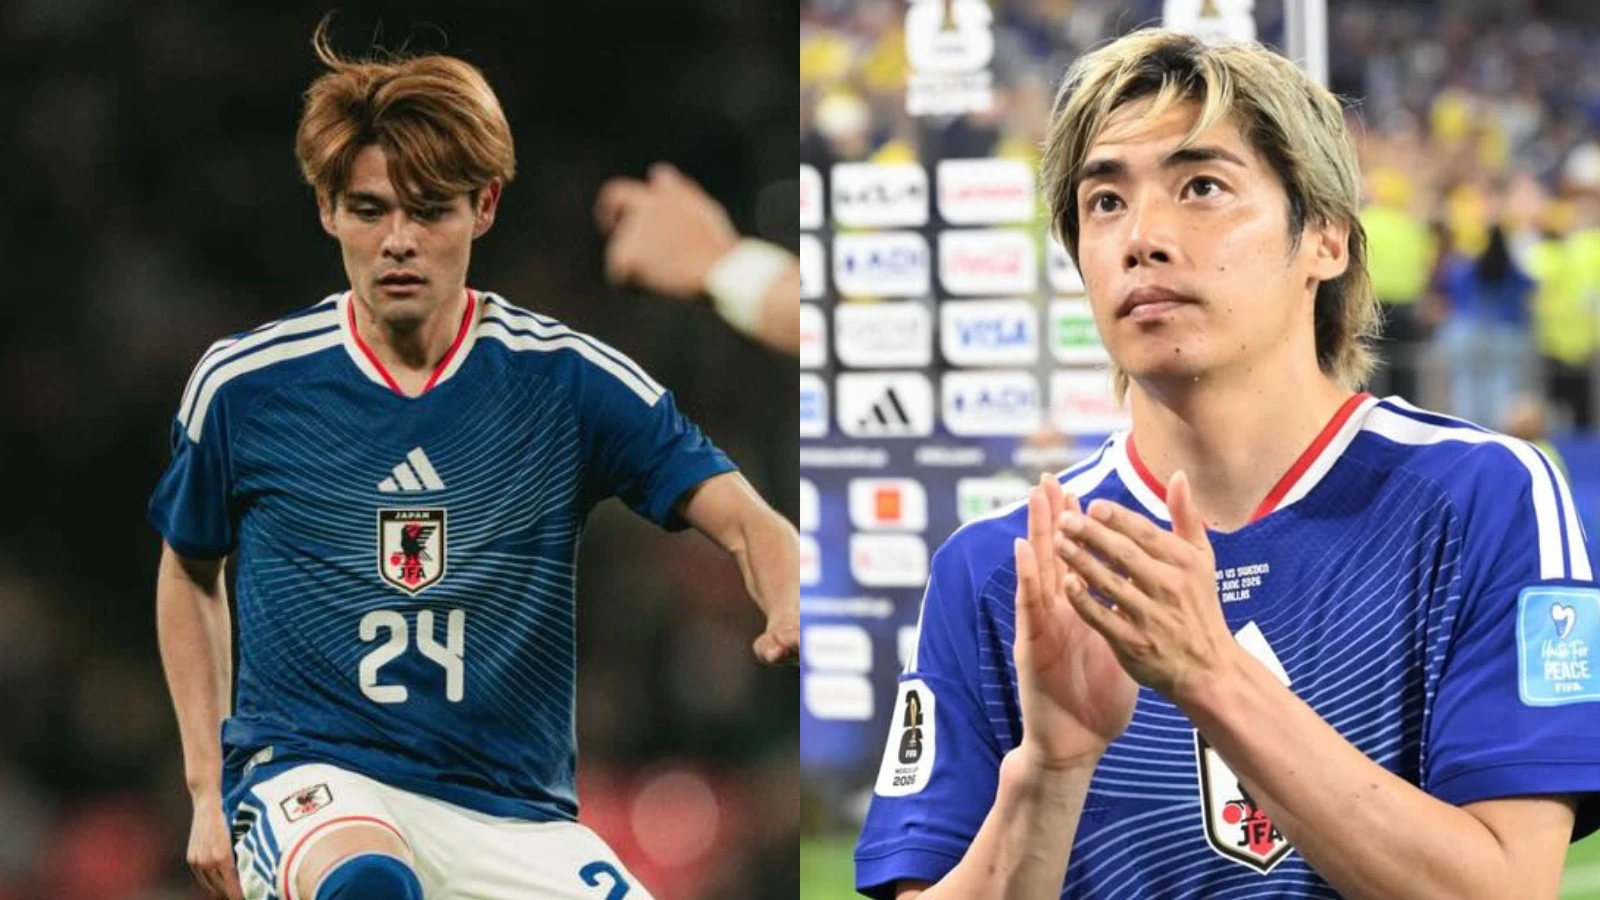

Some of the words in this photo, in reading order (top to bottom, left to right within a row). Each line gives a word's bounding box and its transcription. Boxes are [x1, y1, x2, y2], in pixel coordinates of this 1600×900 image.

[397, 567, 427, 580] JFA
[1237, 563, 1269, 577] SWEDEN
[1222, 589, 1250, 602] DALLAS
[359, 609, 465, 704] 24
[1543, 660, 1591, 681] PEACE
[1237, 823, 1284, 847] JFA
